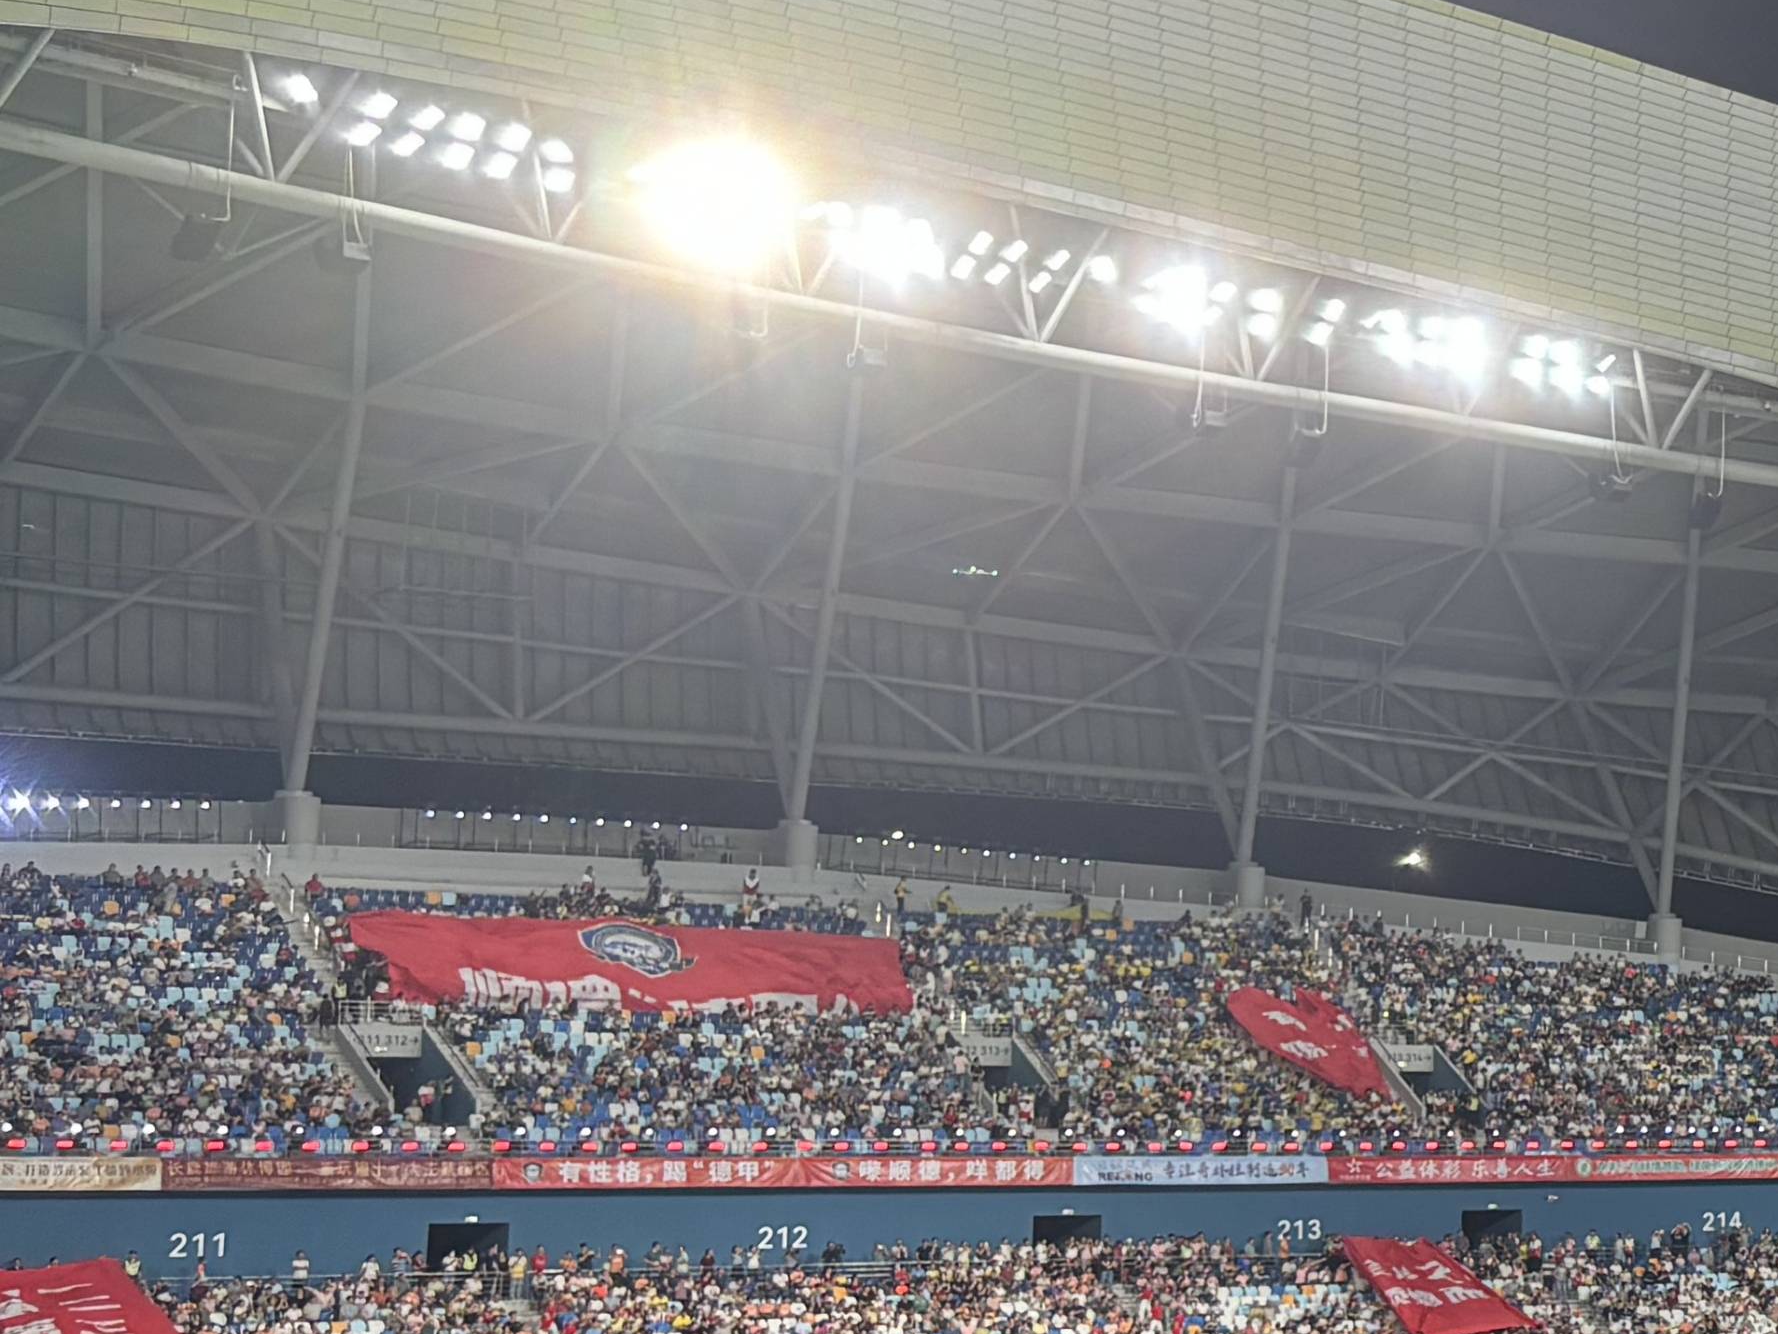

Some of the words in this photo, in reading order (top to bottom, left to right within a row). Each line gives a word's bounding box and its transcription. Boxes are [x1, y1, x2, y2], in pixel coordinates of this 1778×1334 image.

[1277, 1219, 1321, 1240] 213
[1702, 1211, 1742, 1232] 214
[168, 1232, 226, 1258] 211
[757, 1225, 809, 1250] 212
